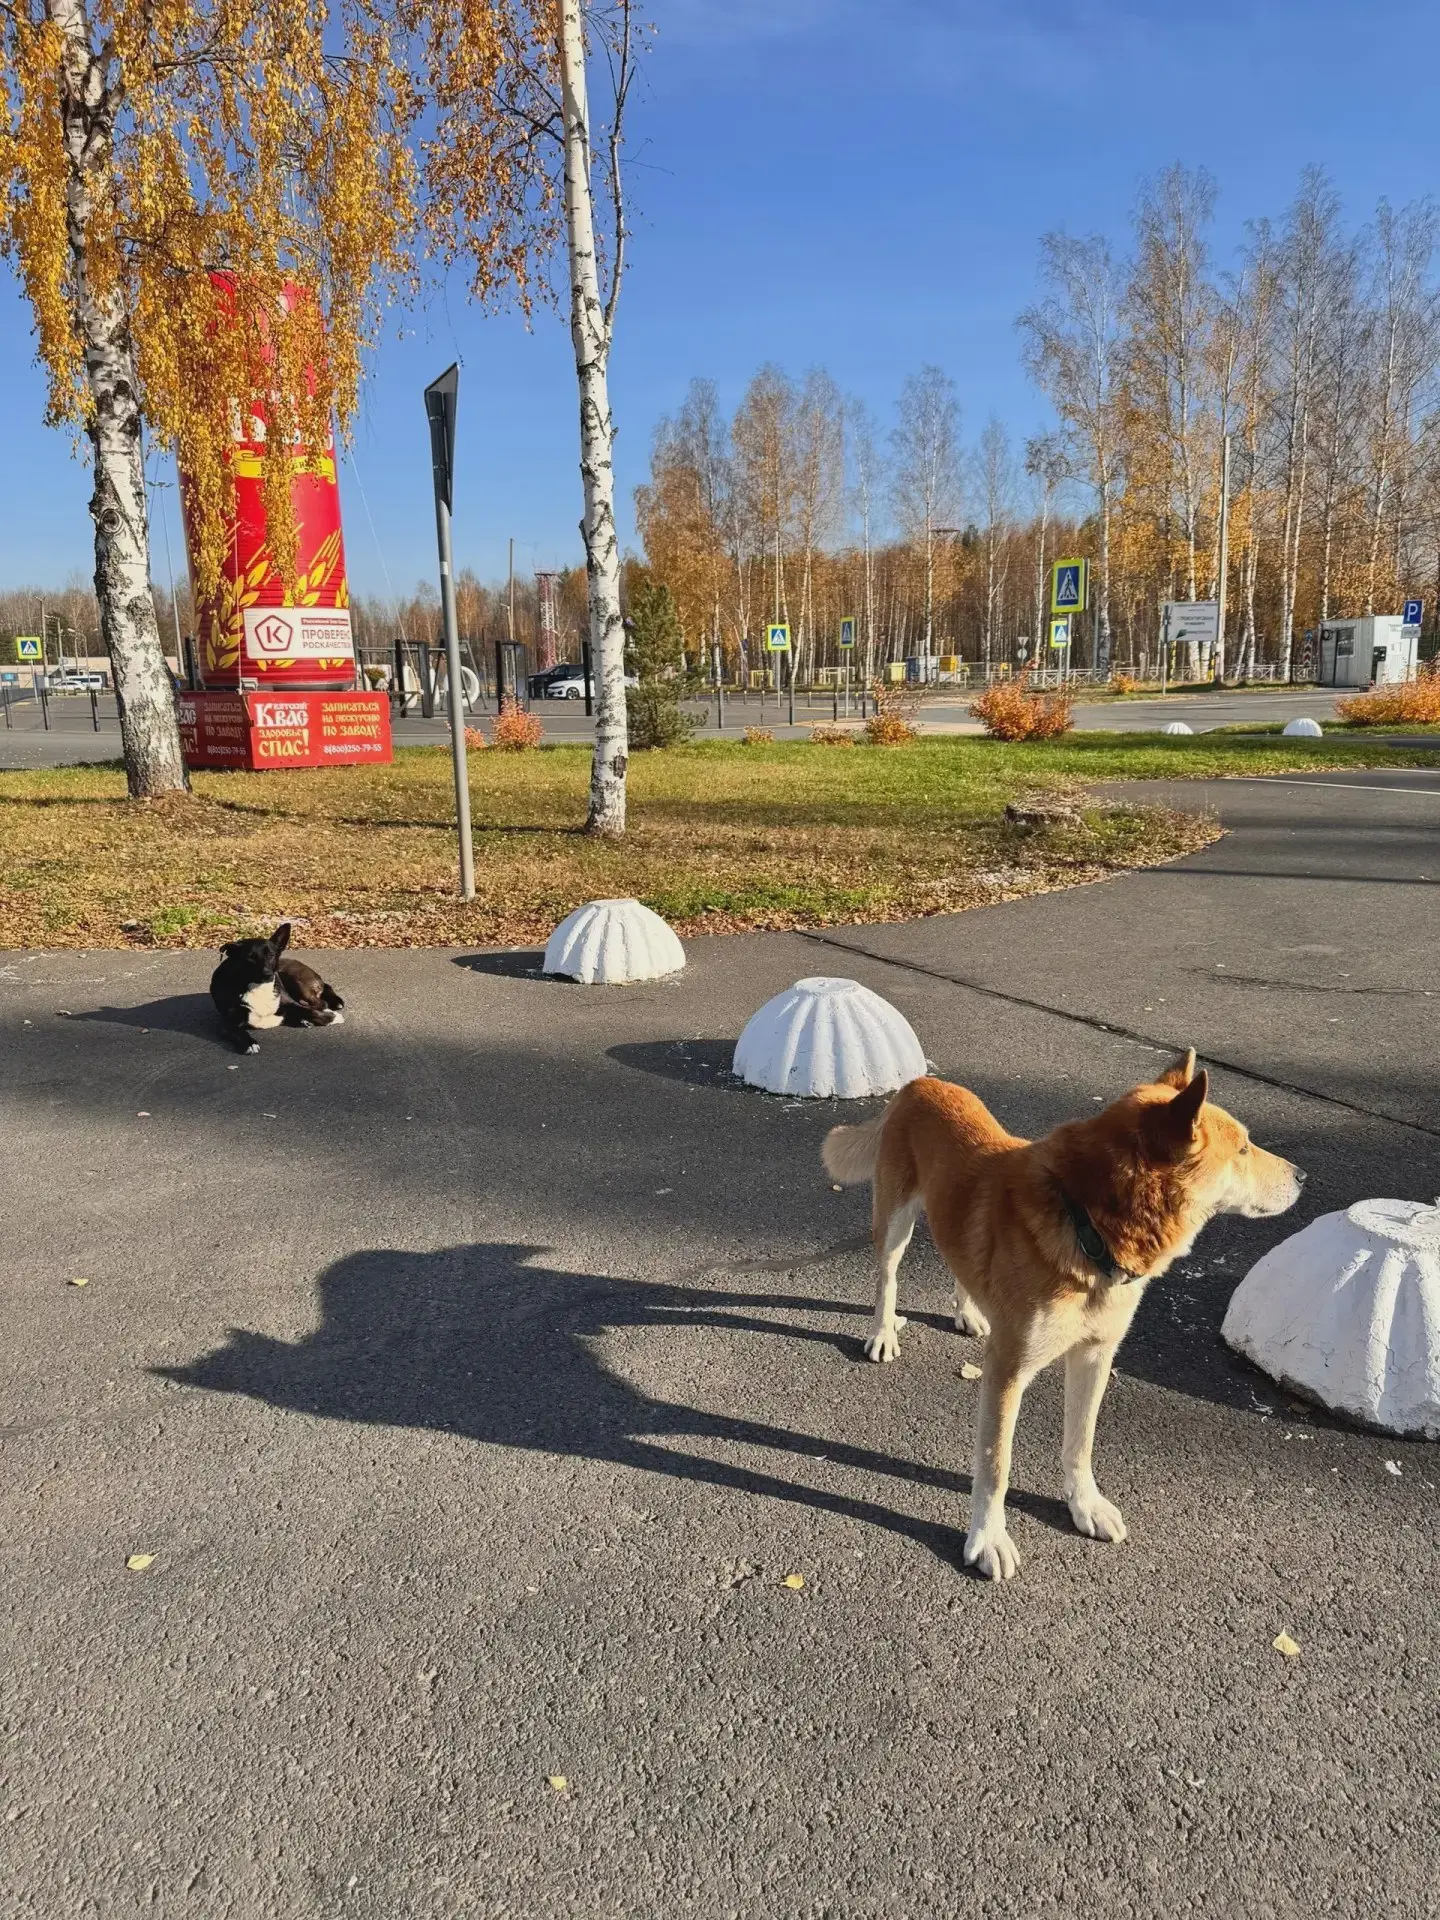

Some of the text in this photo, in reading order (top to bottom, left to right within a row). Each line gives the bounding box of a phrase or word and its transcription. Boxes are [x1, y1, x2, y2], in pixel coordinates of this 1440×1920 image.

[1407, 603, 1418, 622] P
[322, 702, 380, 712] ЗАПИСАТЬСЯ
[322, 714, 334, 723] НА
[323, 725, 338, 737] ПО
